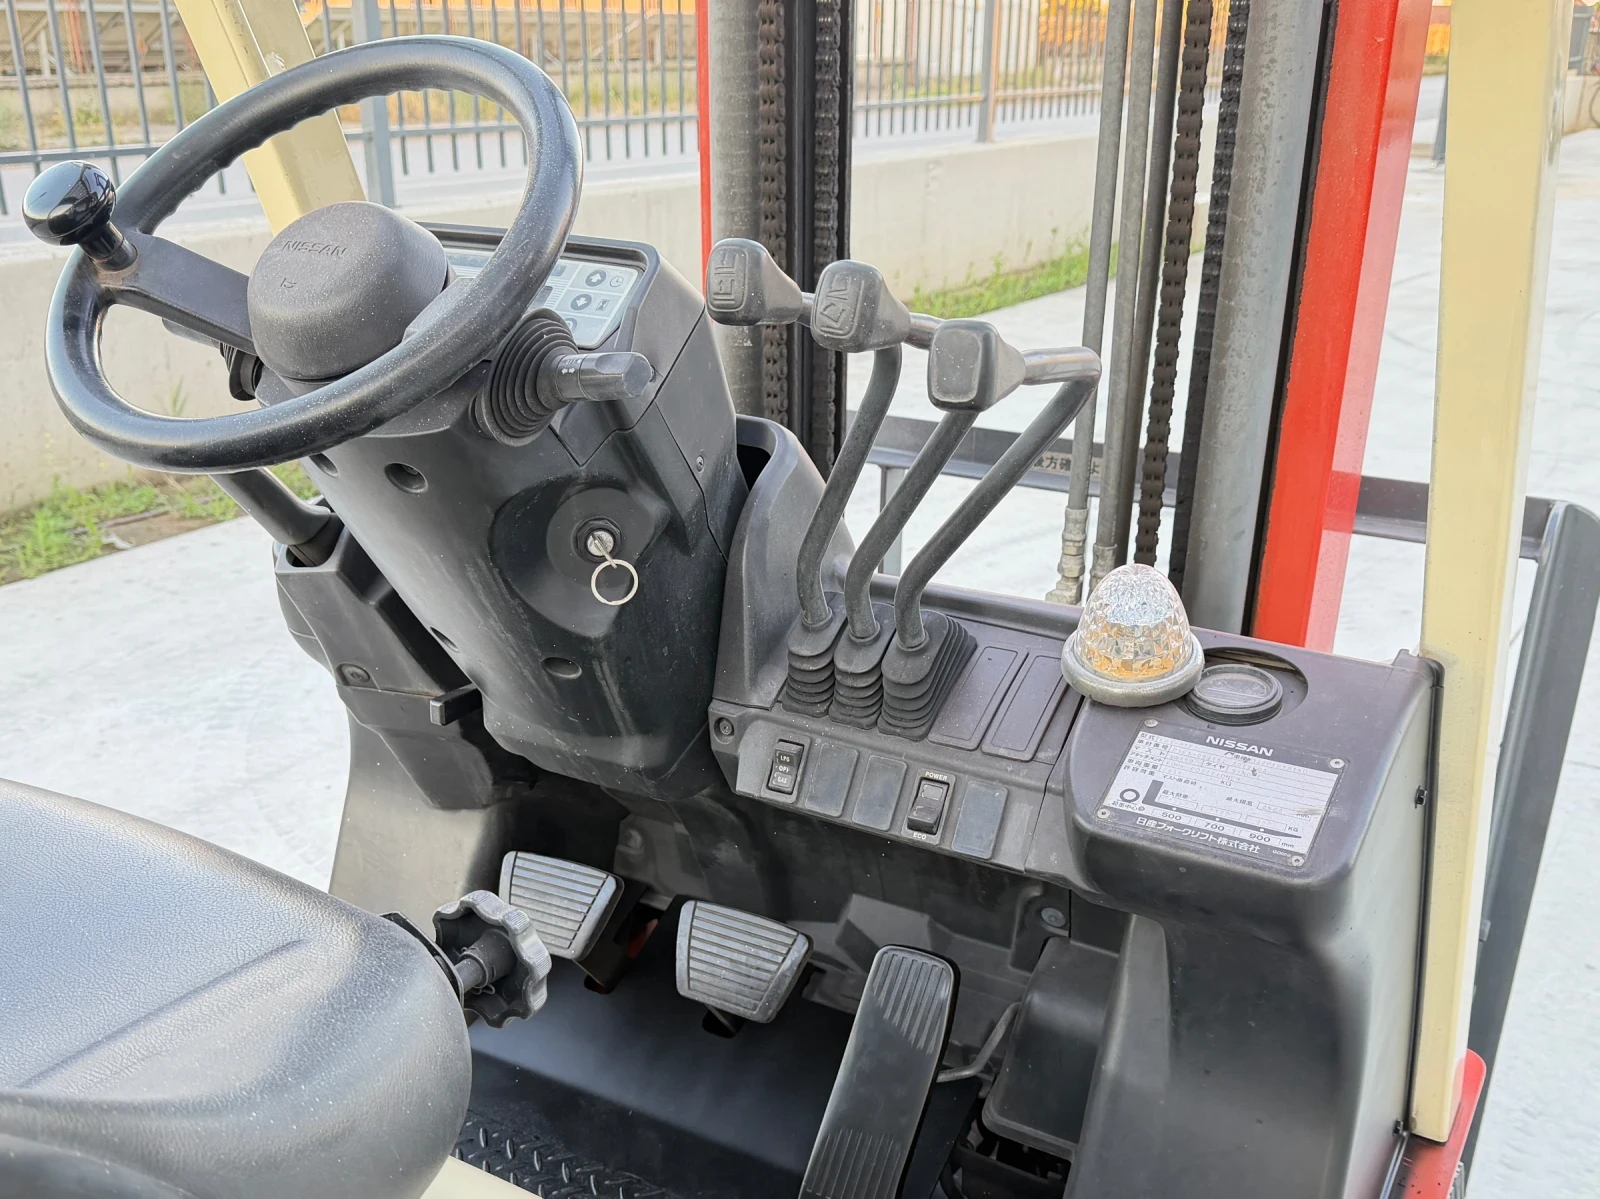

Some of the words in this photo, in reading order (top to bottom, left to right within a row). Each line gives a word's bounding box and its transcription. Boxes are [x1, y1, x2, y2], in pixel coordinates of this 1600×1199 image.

[282, 241, 346, 256] NISSAN
[1205, 735, 1274, 756] NISSAN
[925, 771, 948, 781] POWER
[1161, 811, 1182, 820] 500
[1204, 821, 1225, 832] 700
[1287, 825, 1299, 833] KG
[913, 832, 927, 840] ECO
[1136, 816, 1261, 854] 日産フォークリフト株式会社
[1249, 833, 1271, 843] 900
